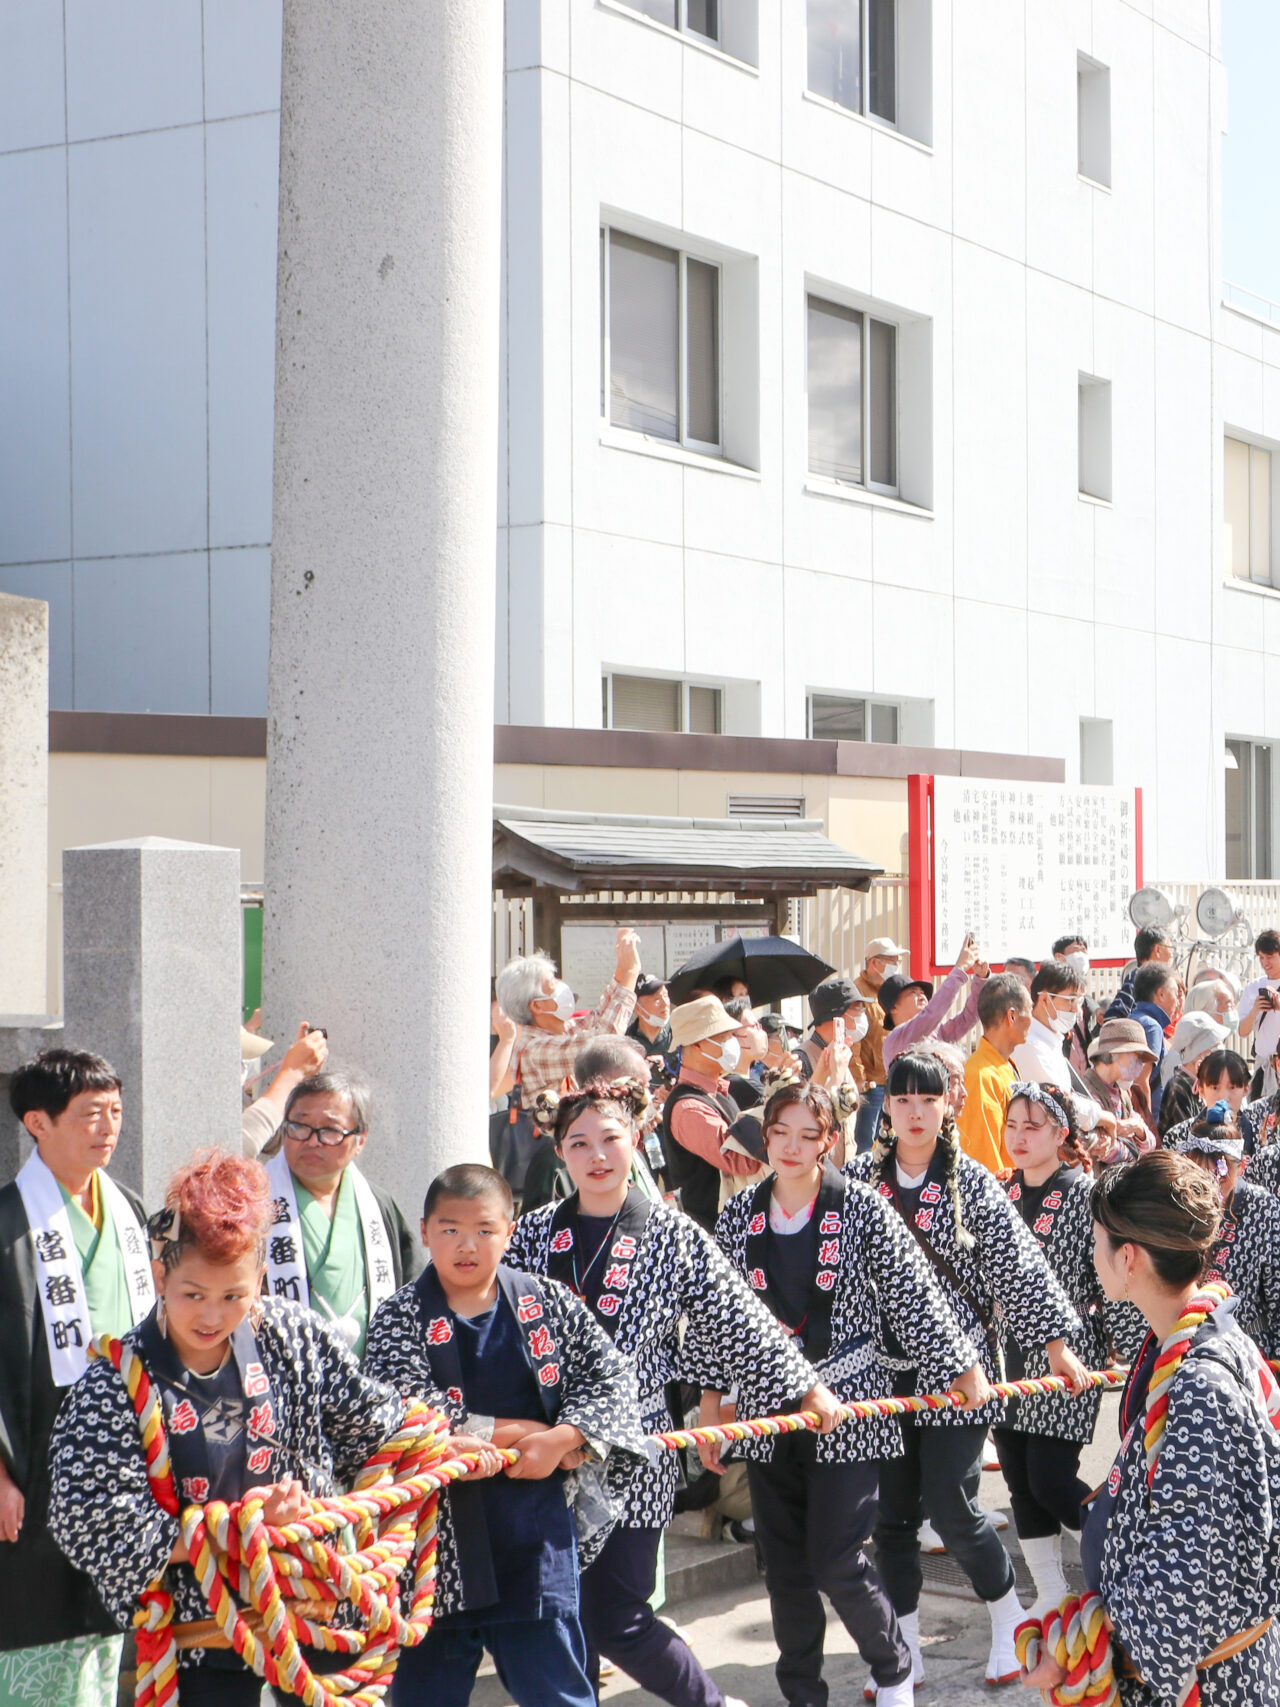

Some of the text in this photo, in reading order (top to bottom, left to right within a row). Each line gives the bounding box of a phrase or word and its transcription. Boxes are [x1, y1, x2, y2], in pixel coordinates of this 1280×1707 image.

[550, 1228, 573, 1252] 若
[915, 1182, 941, 1232] 石橋
[1034, 1191, 1062, 1248] 石橋
[598, 1235, 637, 1316] 石橋町
[816, 1211, 841, 1290] 石橋町
[518, 1295, 560, 1387] 石橋町
[246, 1362, 275, 1474] 石橋町
